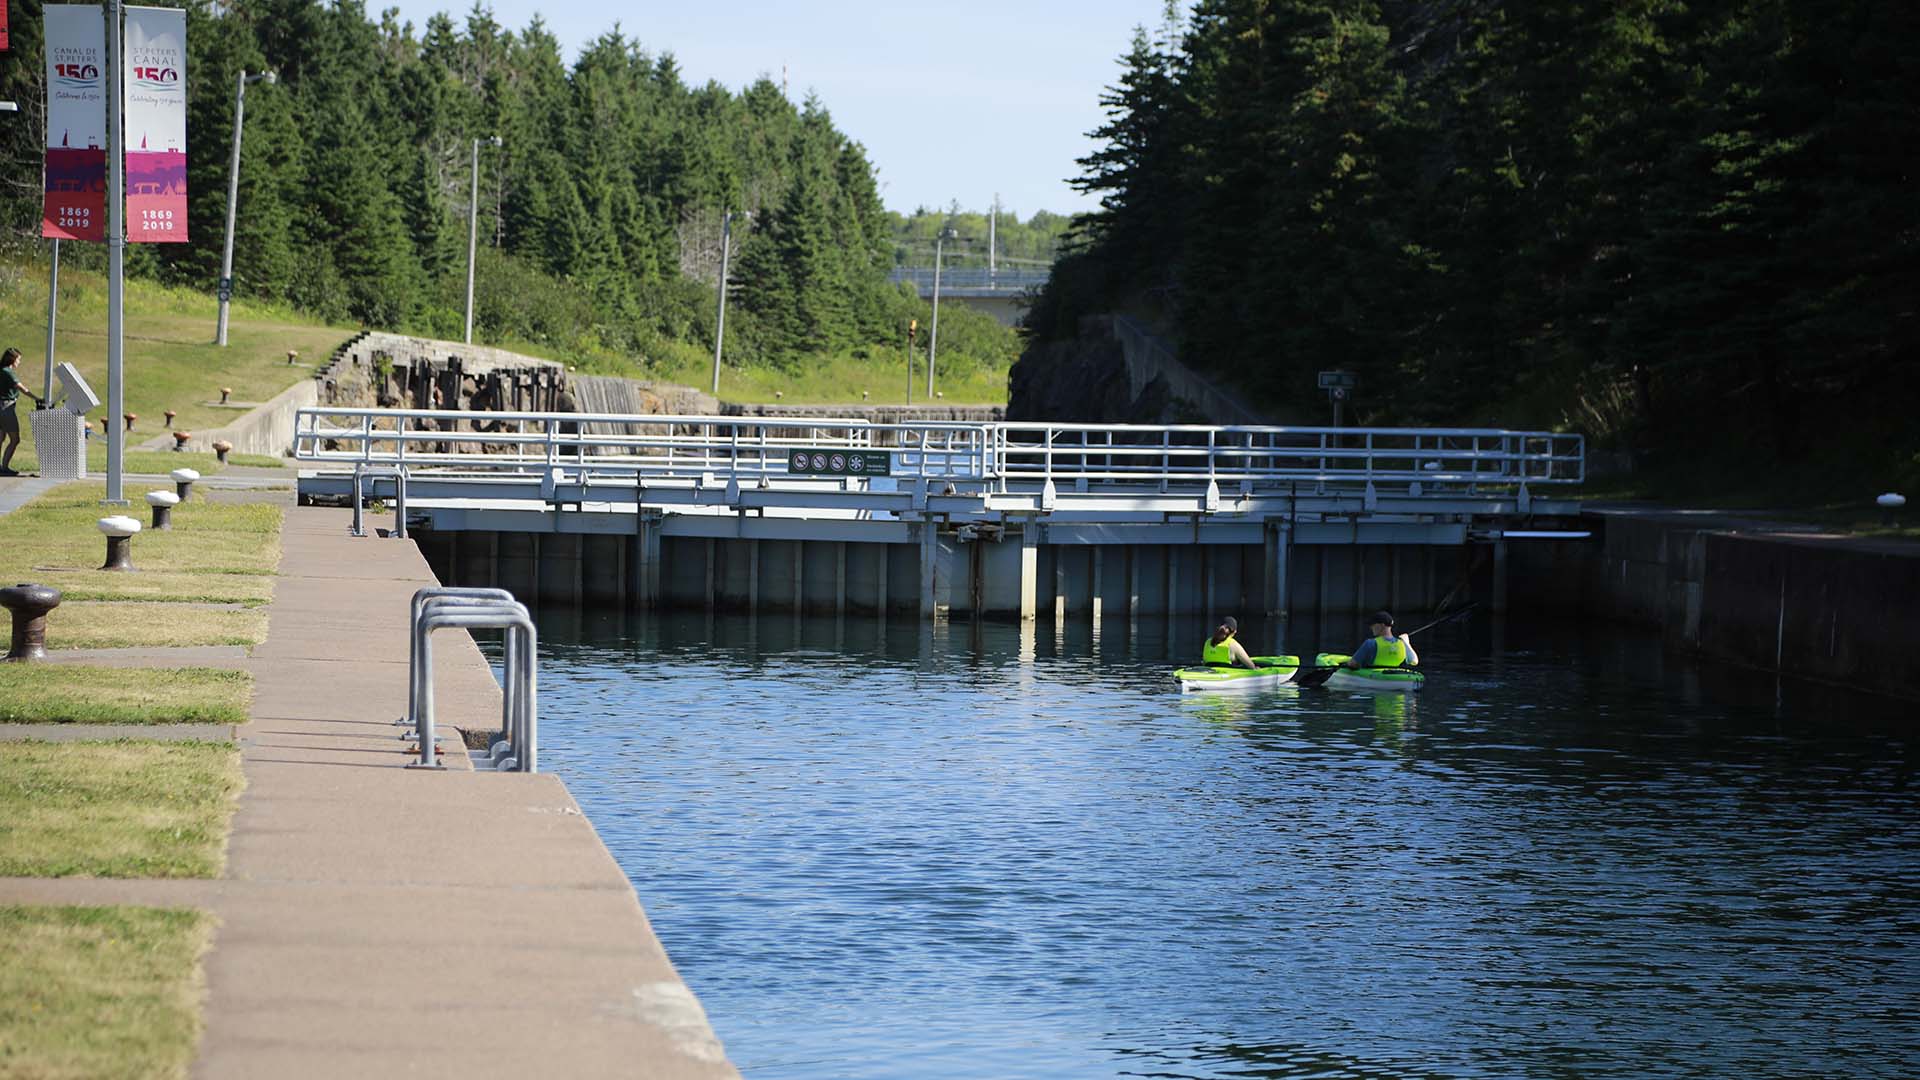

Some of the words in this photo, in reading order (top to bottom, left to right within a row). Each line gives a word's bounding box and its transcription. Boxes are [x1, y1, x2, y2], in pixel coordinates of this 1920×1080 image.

[54, 47, 82, 55] CANAL
[133, 55, 177, 66] CANAL
[55, 63, 98, 80] 150
[133, 66, 178, 82] 150
[60, 207, 90, 217] 1869
[142, 209, 173, 219] 1869
[59, 217, 89, 227] 2019
[142, 220, 173, 230] 2019
